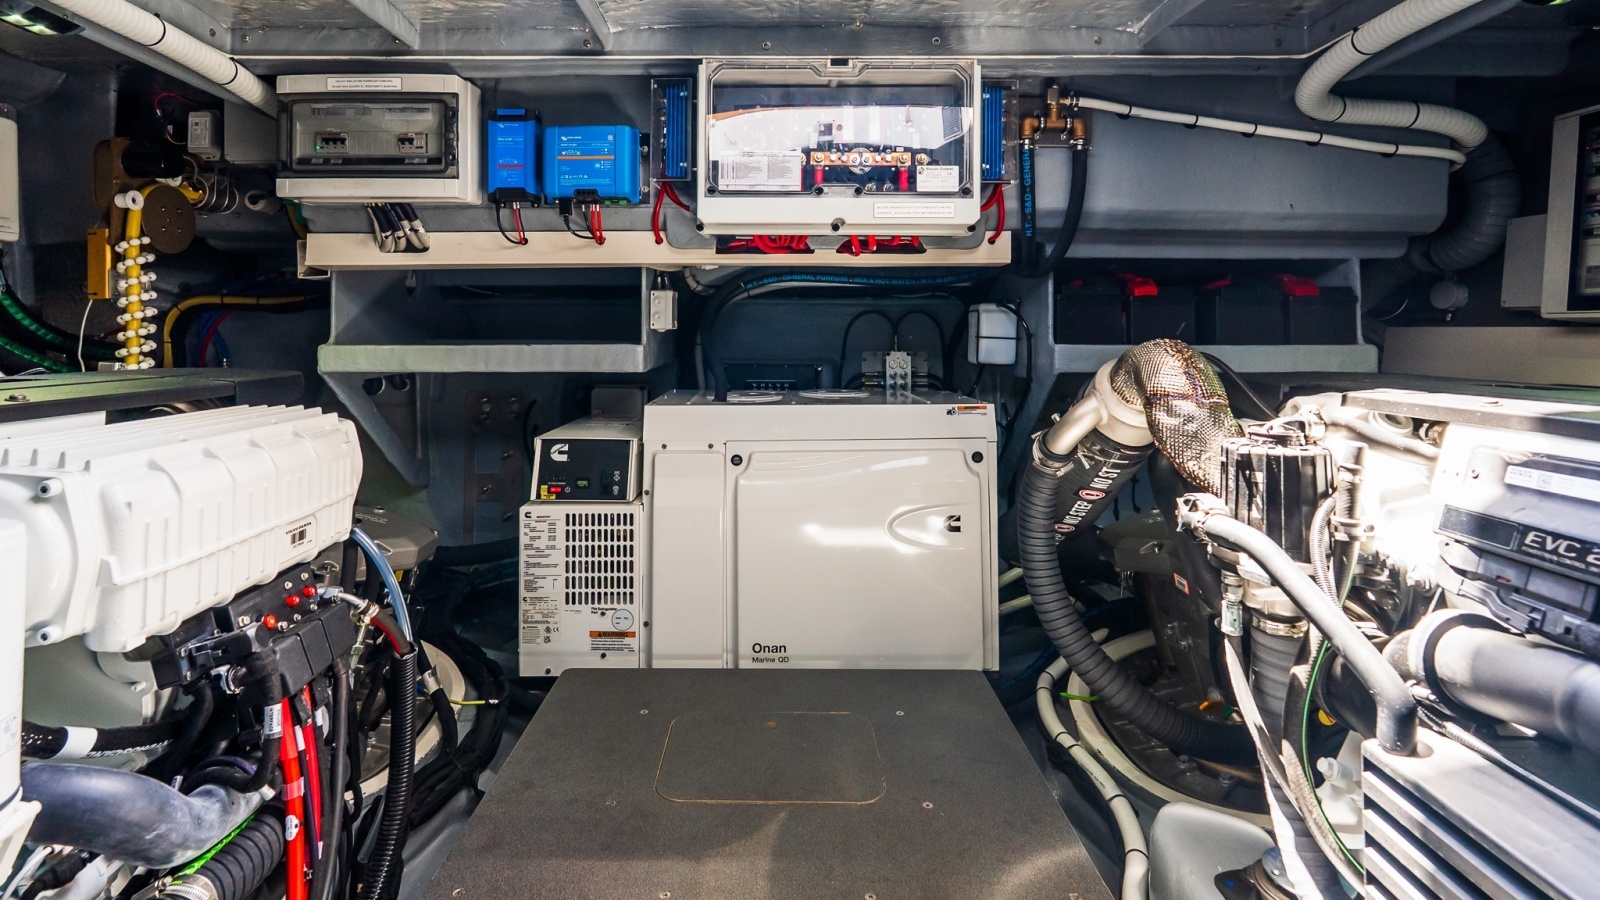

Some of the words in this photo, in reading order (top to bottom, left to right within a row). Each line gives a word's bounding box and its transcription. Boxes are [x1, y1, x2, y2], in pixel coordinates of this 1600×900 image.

[1022, 148, 1032, 186] GENERA
[1024, 194, 1032, 214] S&D
[1090, 477, 1113, 490] NO
[1069, 500, 1093, 517] STEP
[1062, 515, 1082, 525] NO
[1524, 531, 1581, 557] EVC
[752, 642, 787, 654] Onan
